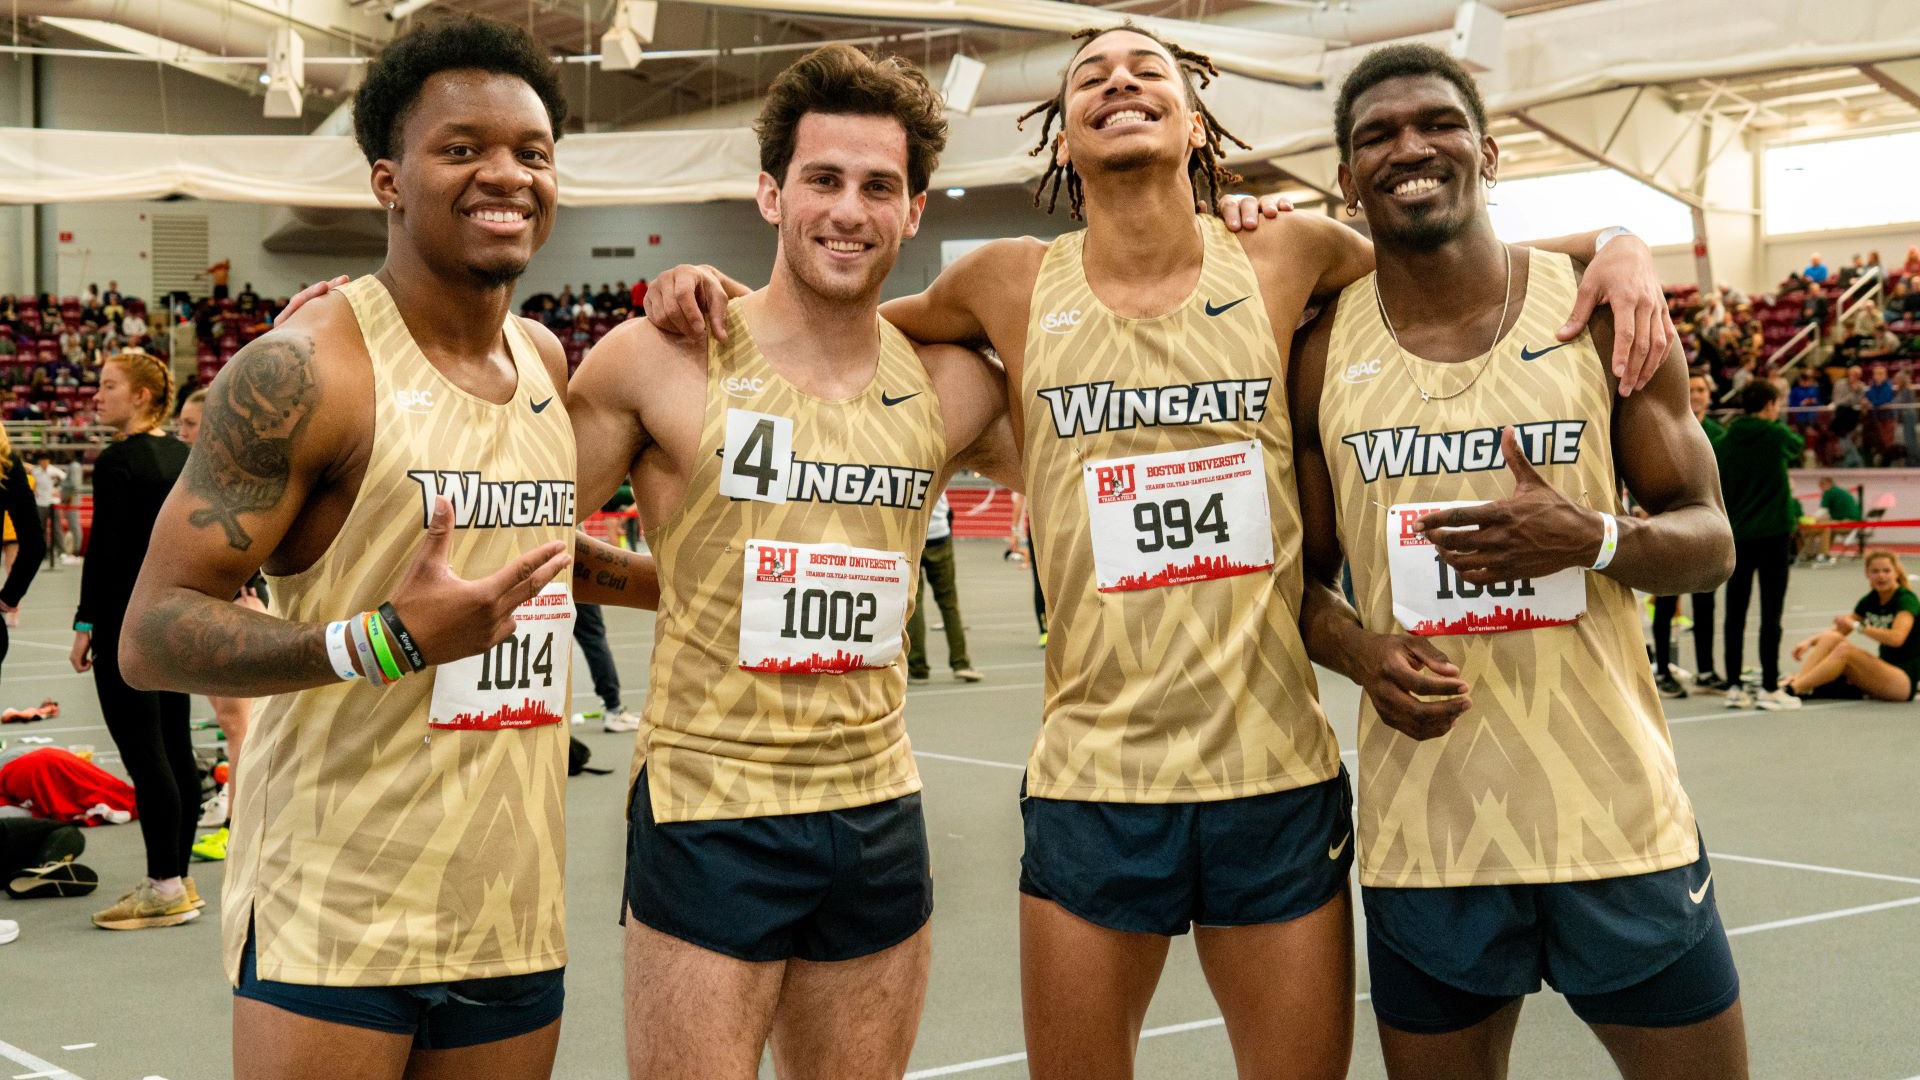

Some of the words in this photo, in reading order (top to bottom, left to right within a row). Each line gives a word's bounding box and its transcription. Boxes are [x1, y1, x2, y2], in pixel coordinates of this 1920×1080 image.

[1045, 310, 1081, 328] SAC
[727, 376, 764, 392] SAC
[1349, 359, 1382, 378] SAC
[398, 390, 433, 407] SAC
[1037, 377, 1272, 439] WINGATE
[733, 418, 778, 496] 4
[1146, 463, 1186, 478] BOSTON
[1188, 453, 1247, 473] UNIVERSITY
[716, 449, 934, 511] INGATE
[1095, 463, 1136, 497] BU
[407, 470, 575, 529] WINGATE
[1133, 492, 1230, 553] 994
[757, 546, 799, 577] BU
[810, 553, 847, 566] BOSTON
[849, 557, 896, 570] UNIVERSITY
[781, 587, 877, 642] 1002
[477, 632, 553, 690] 1014
